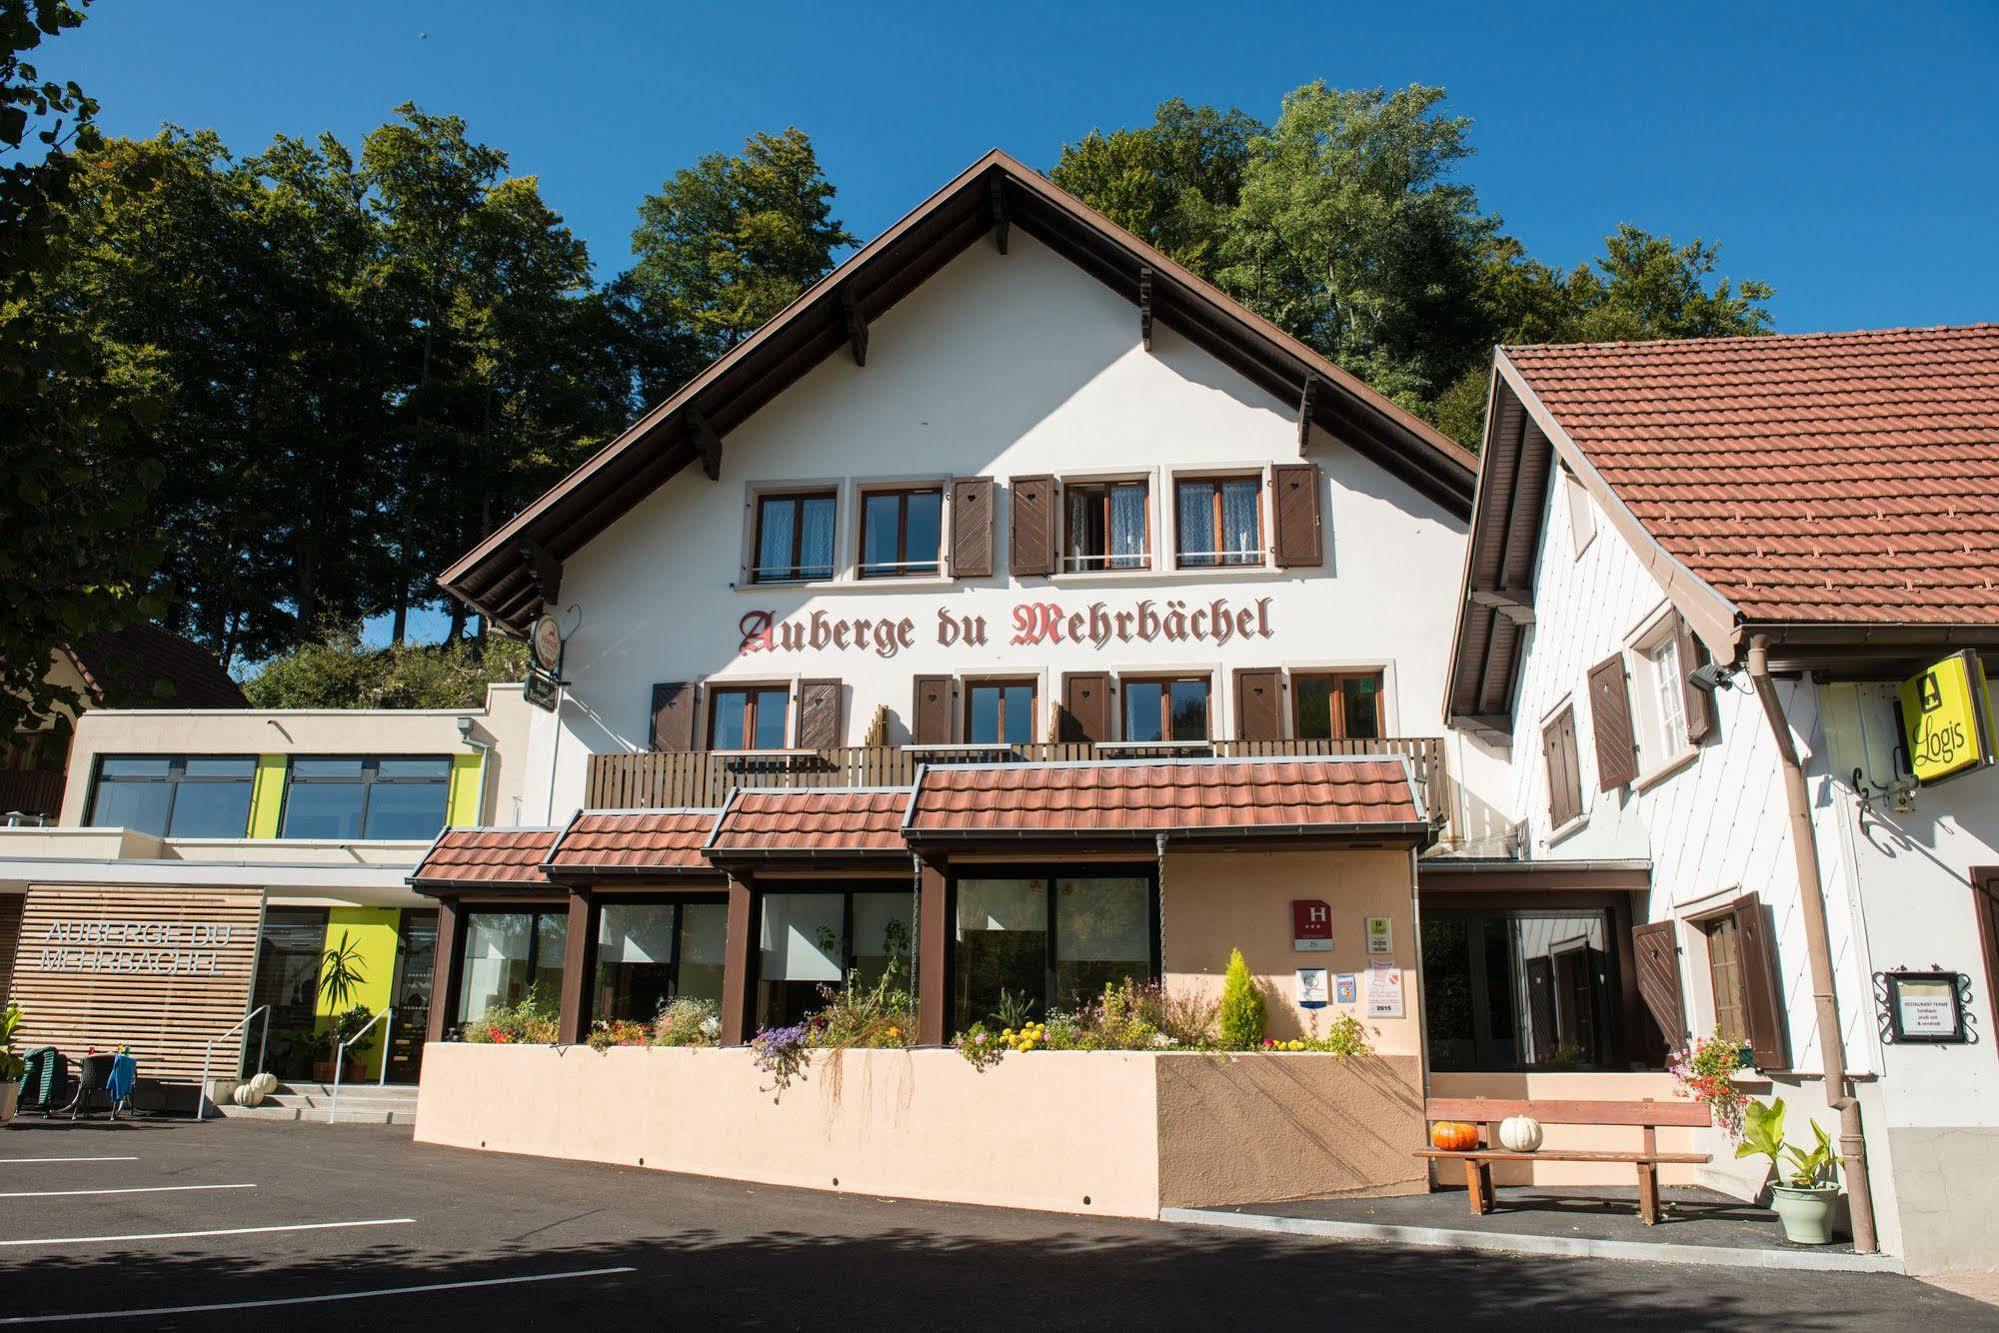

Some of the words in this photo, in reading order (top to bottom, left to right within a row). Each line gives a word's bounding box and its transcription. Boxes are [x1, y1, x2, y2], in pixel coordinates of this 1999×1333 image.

[739, 608, 915, 658] Auberge
[936, 606, 988, 648] du
[1010, 597, 1275, 651] Mehrbächel
[1912, 715, 1965, 767] Logis
[1310, 906, 1327, 922] H
[45, 920, 182, 947] AUBERGE
[191, 924, 232, 947] DU
[39, 947, 226, 976] MEHRBACHEL
